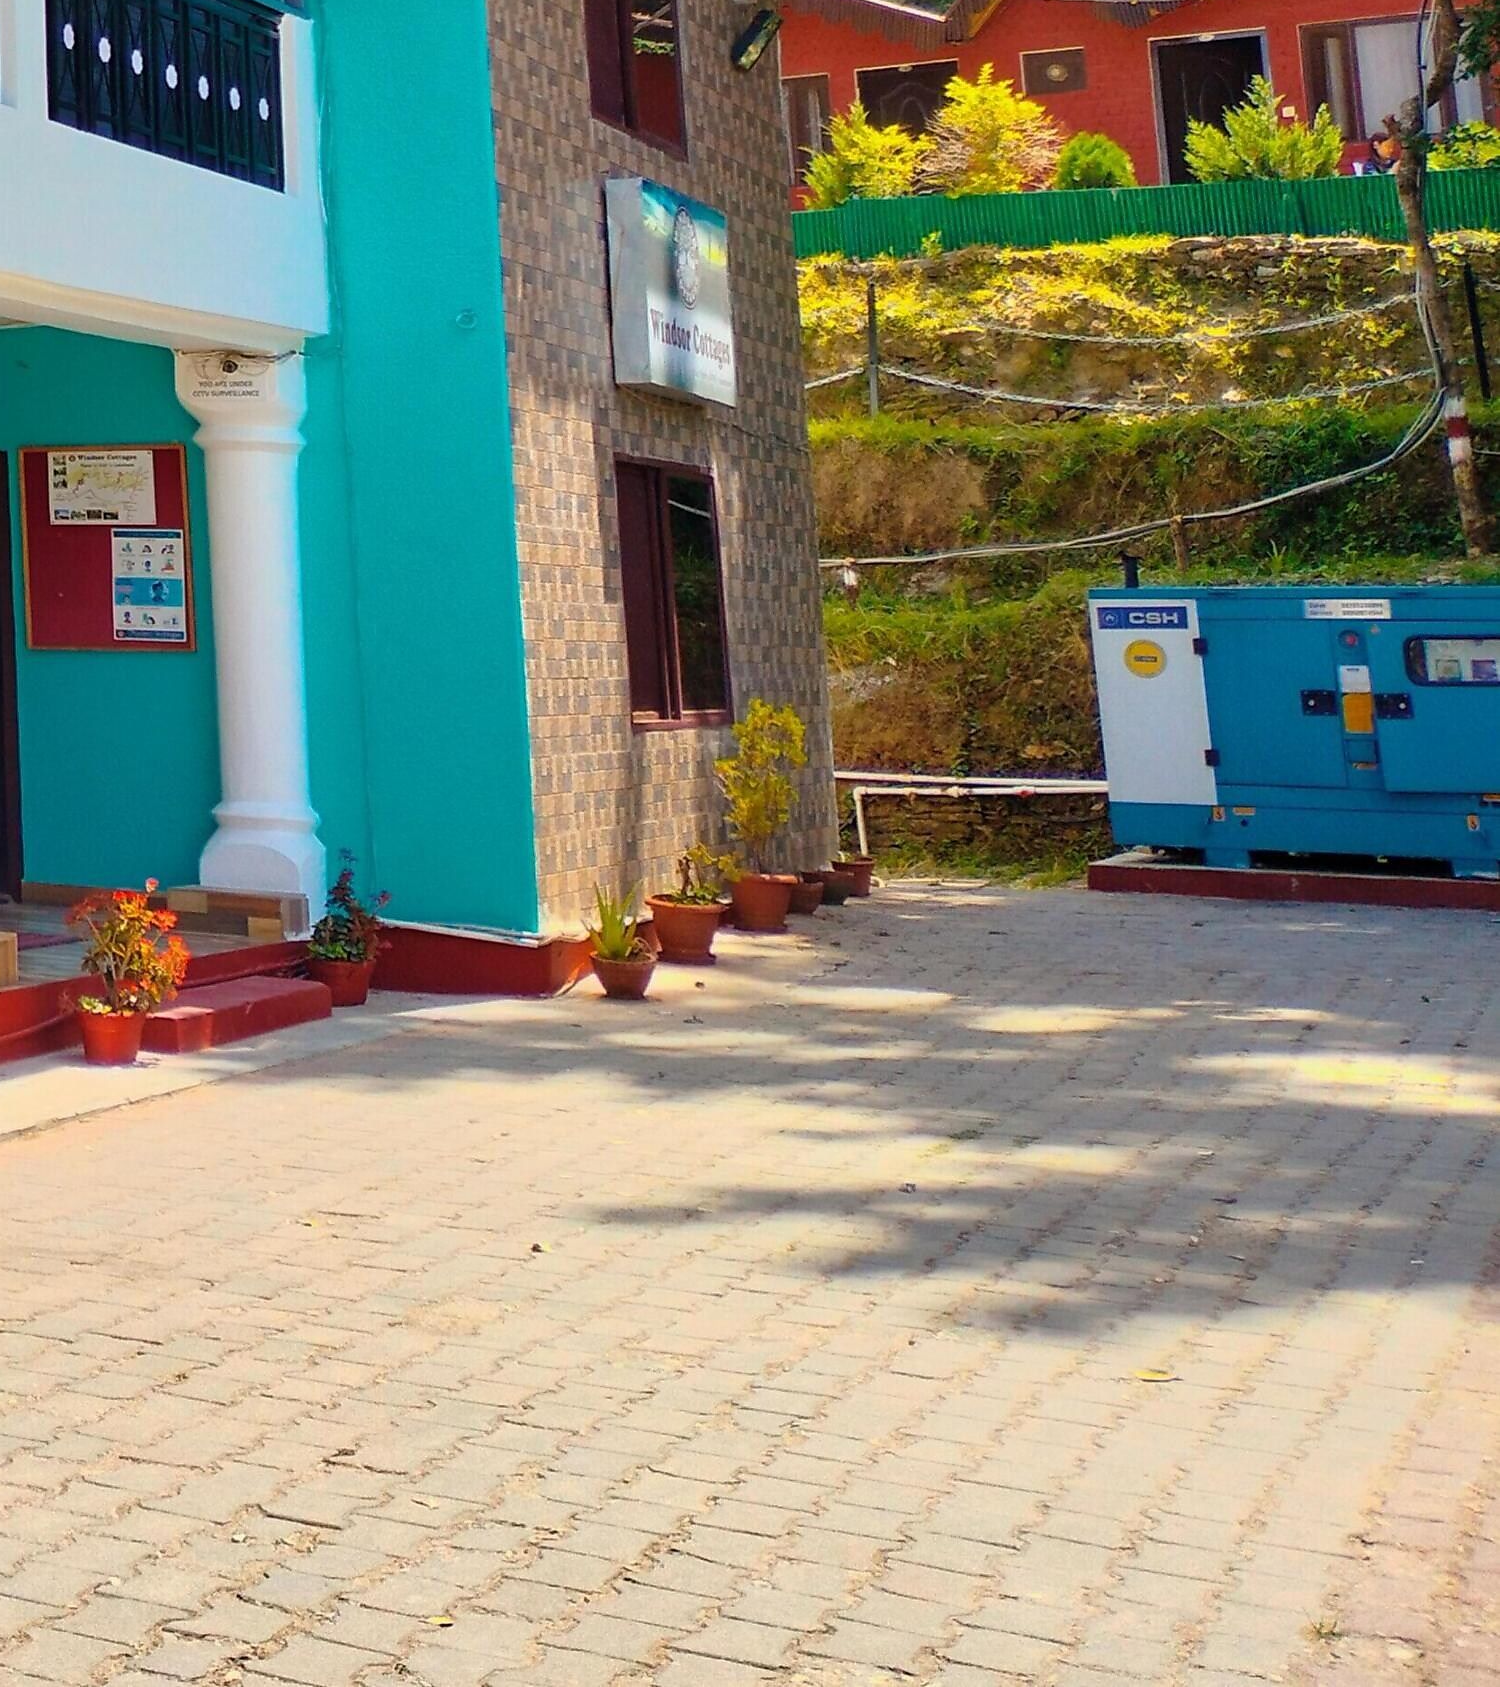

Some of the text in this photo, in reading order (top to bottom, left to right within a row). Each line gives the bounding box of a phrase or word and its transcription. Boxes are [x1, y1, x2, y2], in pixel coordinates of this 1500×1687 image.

[650, 308, 730, 370] Windsor Cottages
[1128, 612, 1178, 624] CSH
